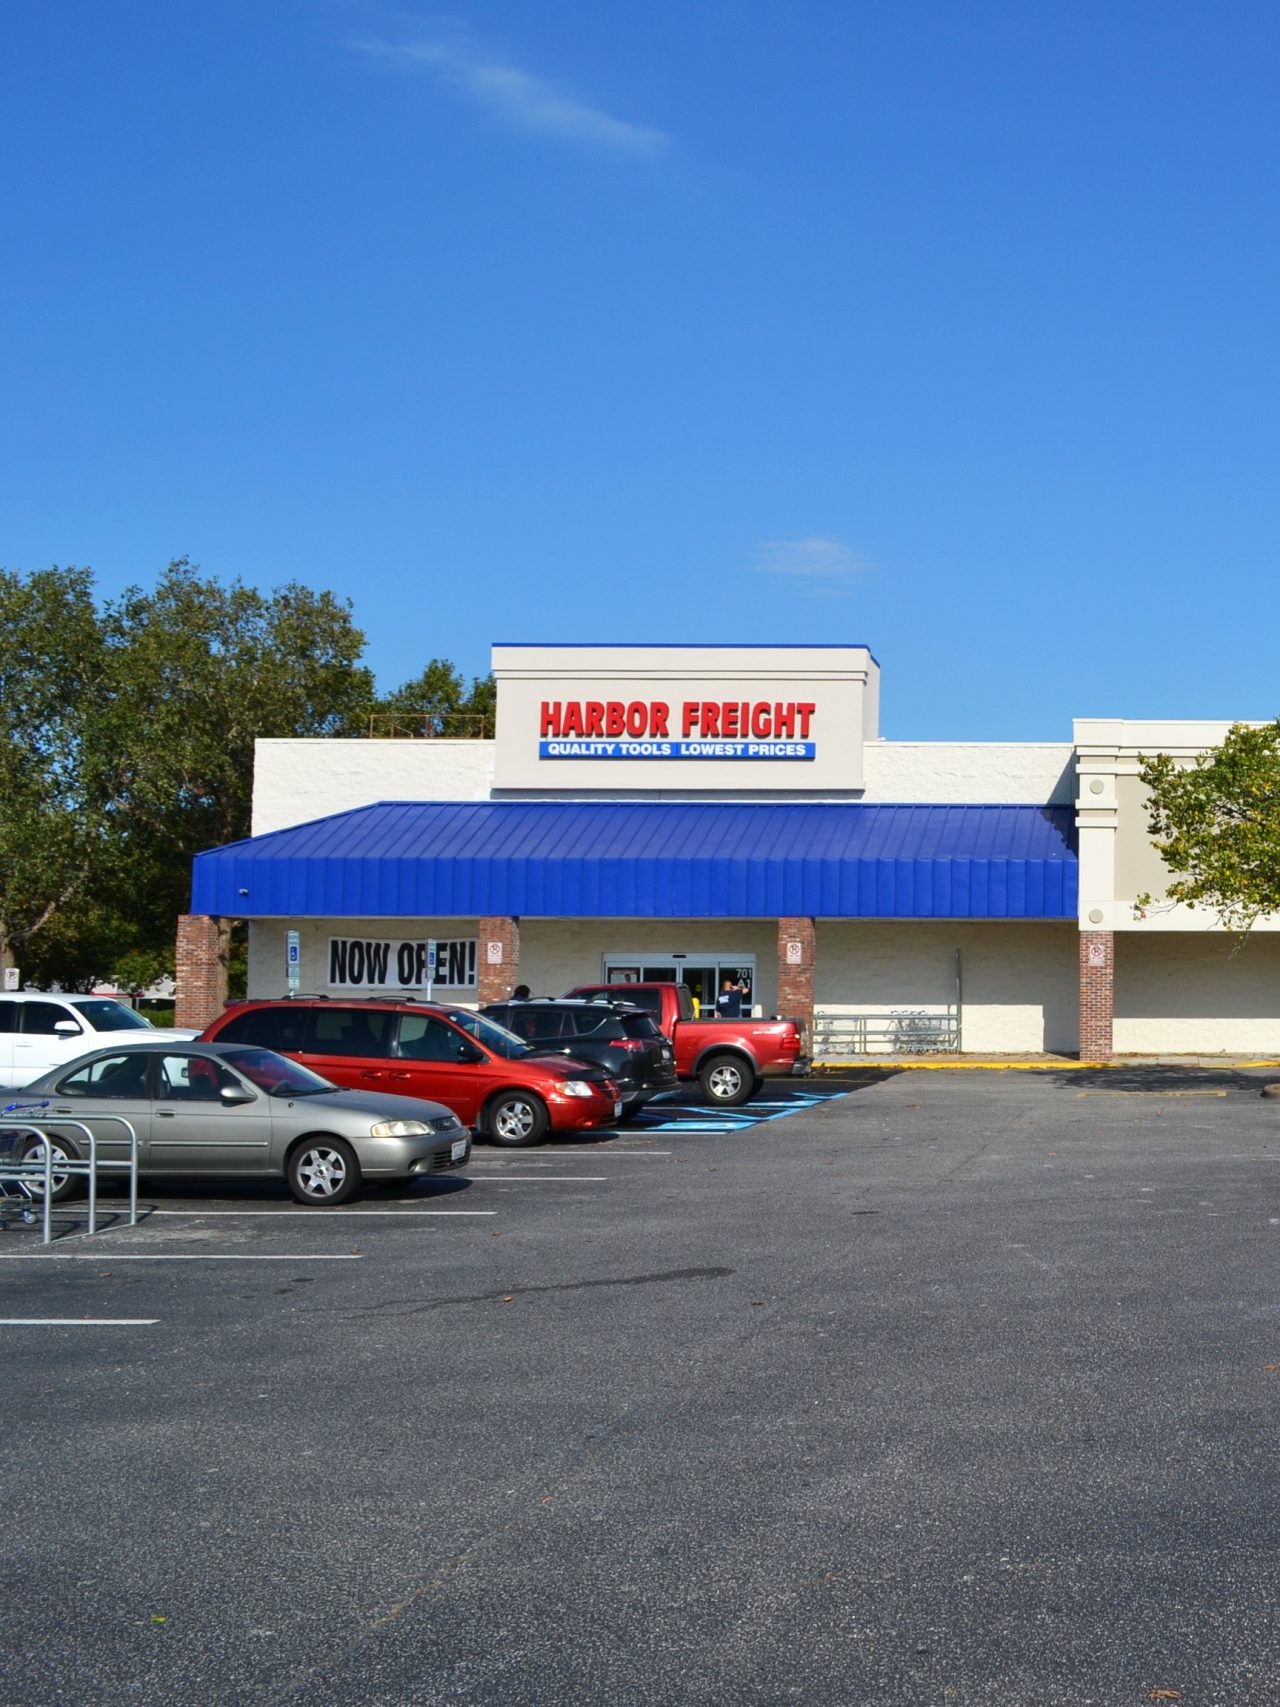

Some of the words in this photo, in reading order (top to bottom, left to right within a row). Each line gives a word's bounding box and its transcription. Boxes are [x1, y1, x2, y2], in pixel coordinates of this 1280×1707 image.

[540, 701, 670, 738] HARBOR
[682, 701, 816, 739] FREIGHT
[548, 743, 614, 755] QUALITY
[620, 743, 671, 755] TOOLS
[681, 744, 742, 756] LOWEST
[749, 744, 806, 756] PRICES
[330, 940, 390, 984] NOW
[397, 941, 476, 985] OPEN!
[736, 968, 752, 978] 701
